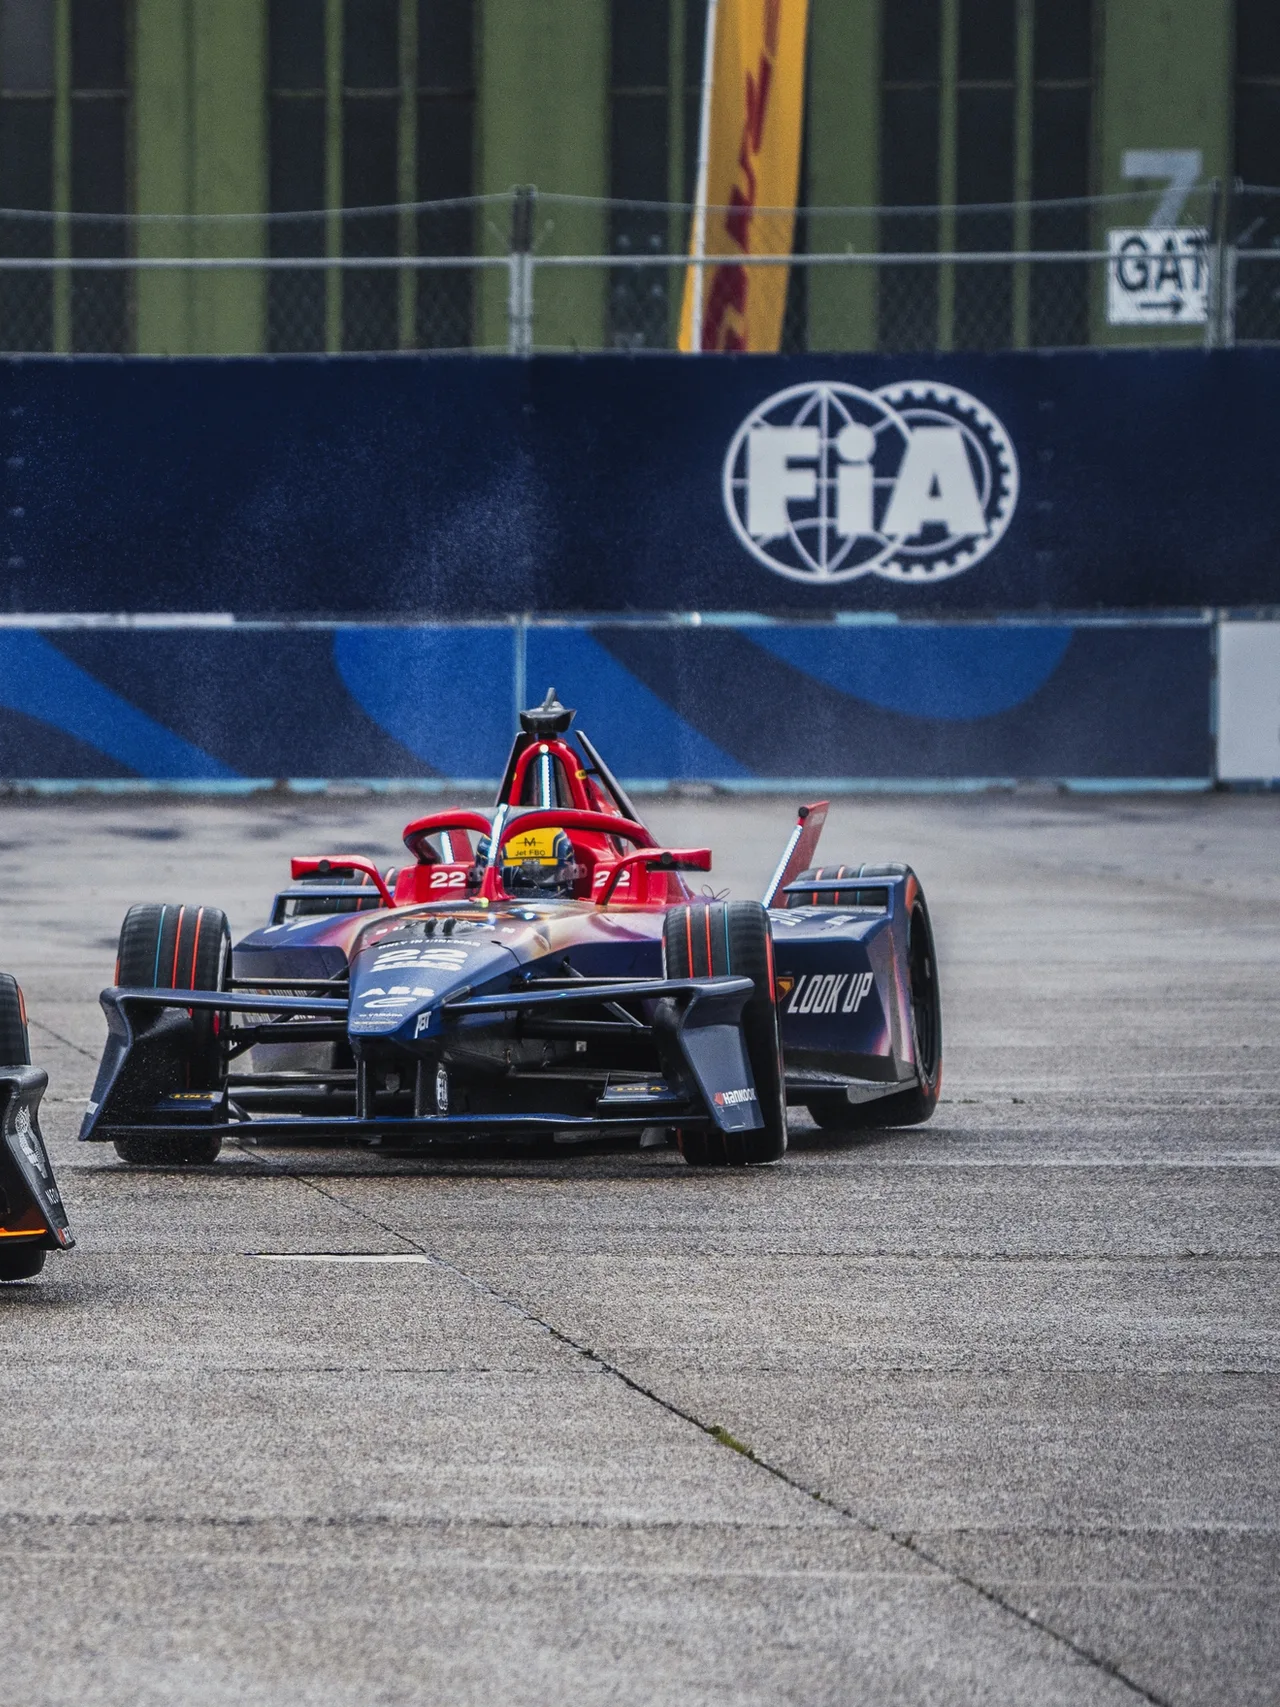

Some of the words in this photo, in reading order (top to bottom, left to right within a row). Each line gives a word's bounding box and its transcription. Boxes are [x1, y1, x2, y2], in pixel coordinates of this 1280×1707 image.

[1123, 149, 1203, 228] 7
[430, 871, 467, 889] 22
[593, 870, 631, 888] 22
[373, 948, 469, 966] 22
[357, 986, 435, 999] ABB
[787, 973, 848, 1014] LOOK
[842, 972, 874, 1013] UP
